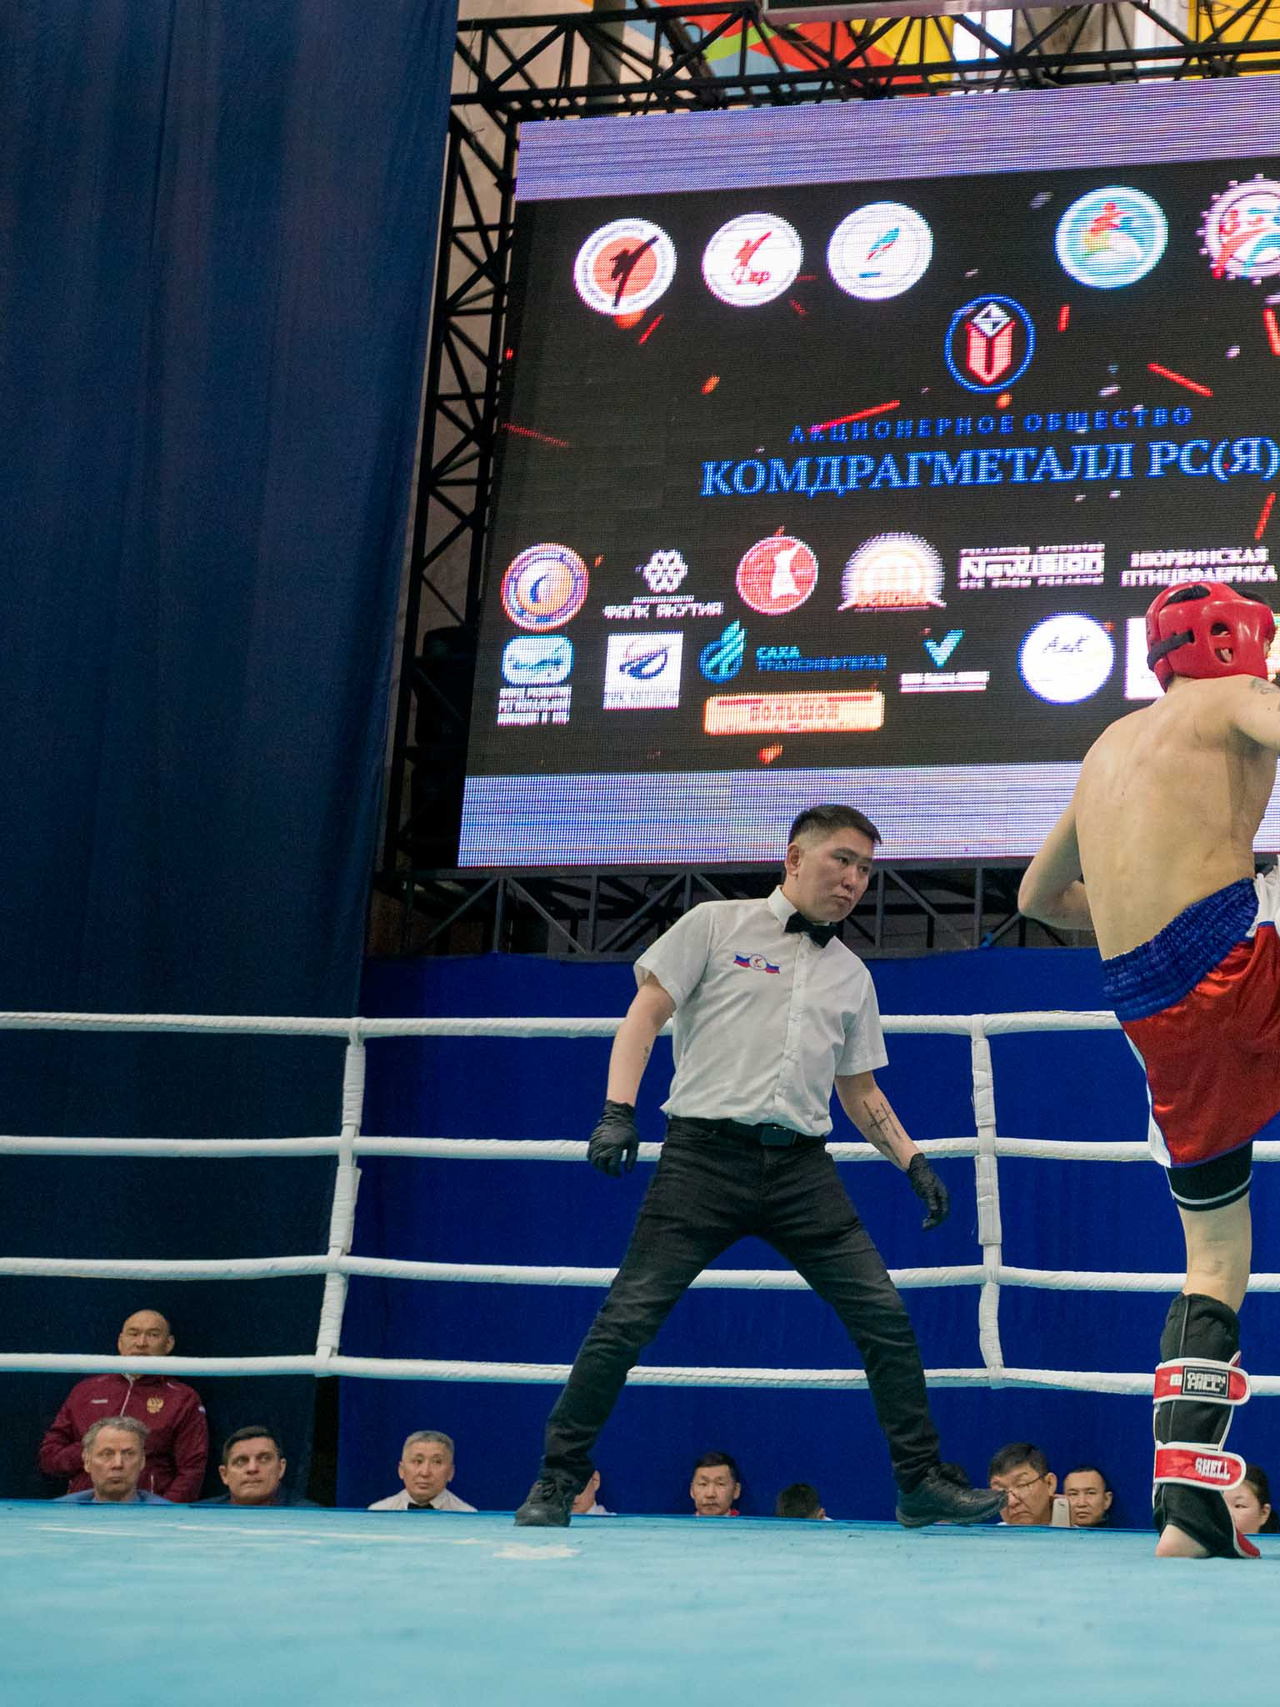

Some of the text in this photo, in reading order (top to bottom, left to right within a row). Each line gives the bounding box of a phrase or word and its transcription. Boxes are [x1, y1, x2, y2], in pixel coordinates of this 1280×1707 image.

[788, 406, 1193, 445] АКЦИОНЕРНОЕ ОБЩЕСТВО
[700, 443, 1136, 498] КОМДРАГМЕТАЛЛ
[1186, 1372, 1227, 1385] GREEN
[1186, 1379, 1222, 1392] HILL
